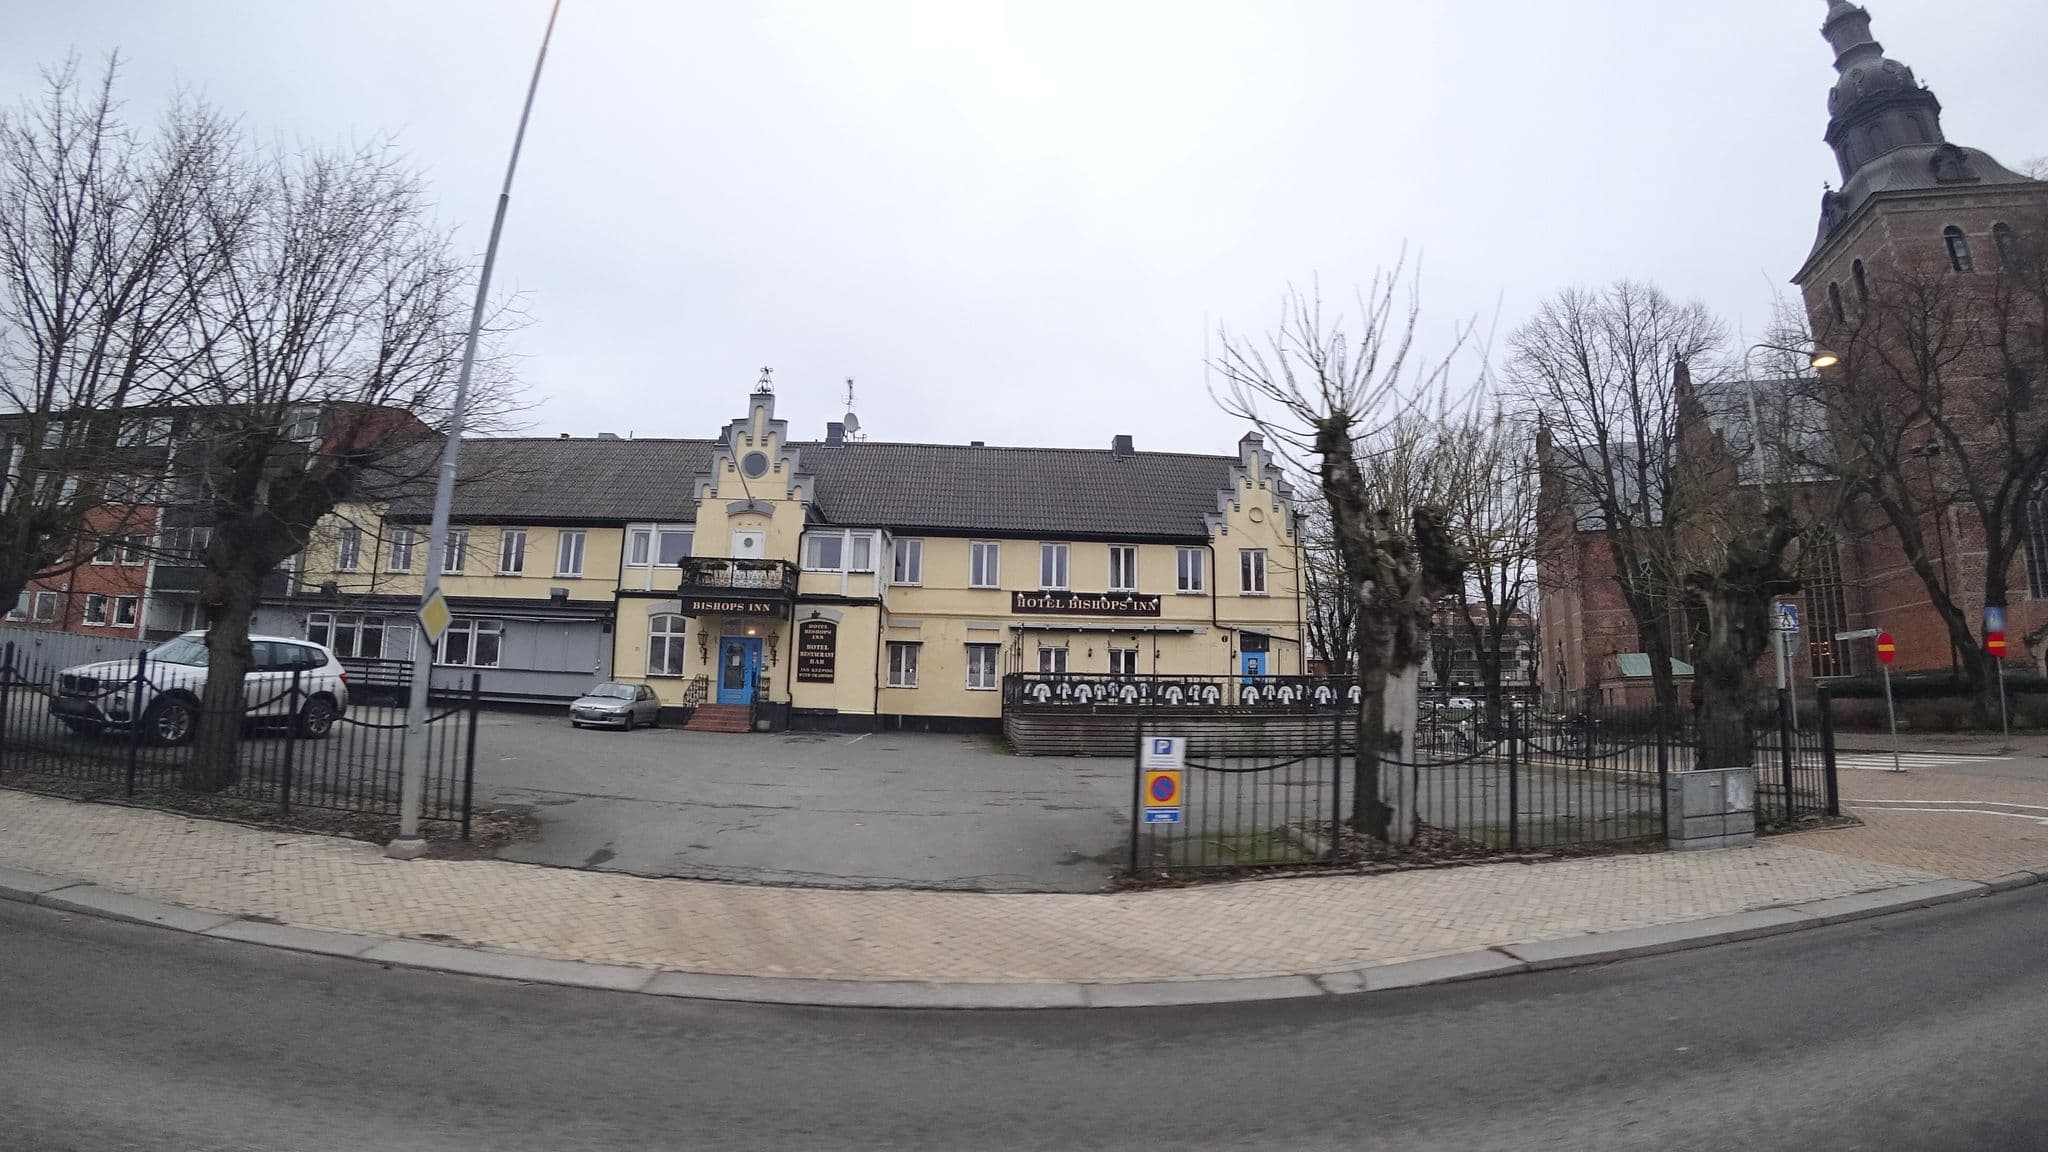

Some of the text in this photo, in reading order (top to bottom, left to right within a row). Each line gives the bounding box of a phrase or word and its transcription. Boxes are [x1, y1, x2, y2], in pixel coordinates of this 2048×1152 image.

[693, 601, 770, 612] BISHOPS INN
[1017, 598, 1157, 611] HOTEL BISHOPS INN
[1157, 740, 1169, 754] P
